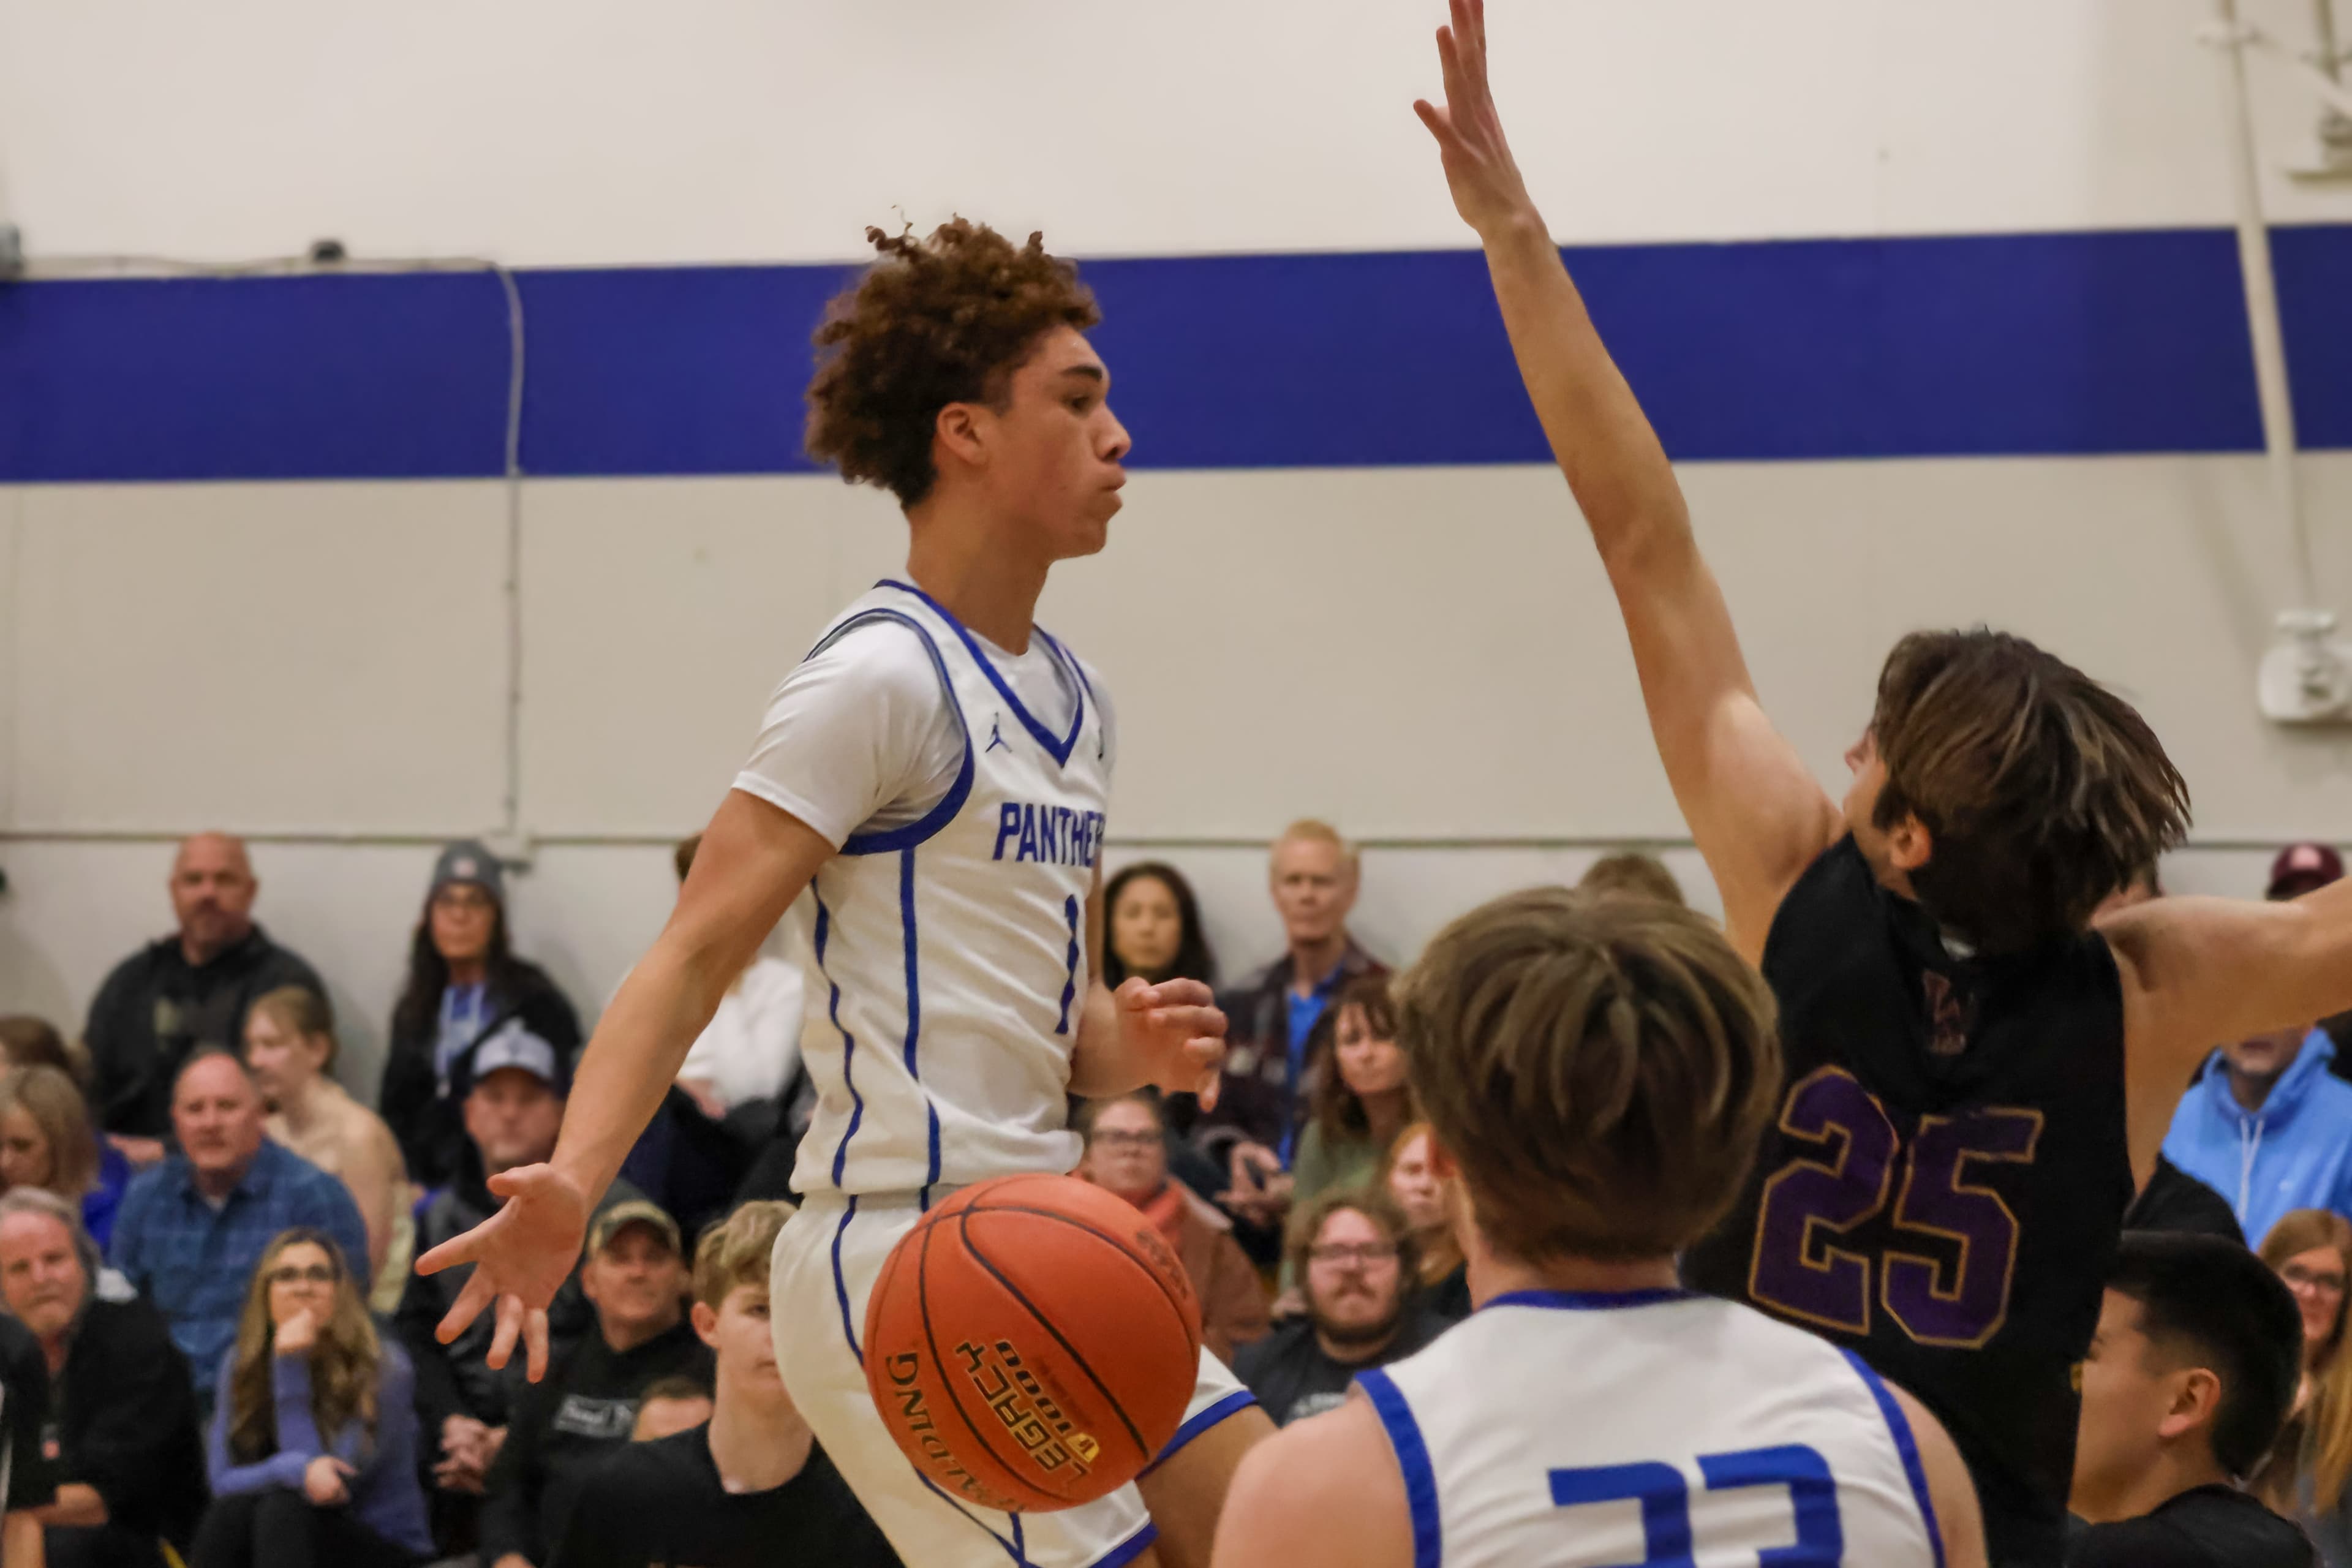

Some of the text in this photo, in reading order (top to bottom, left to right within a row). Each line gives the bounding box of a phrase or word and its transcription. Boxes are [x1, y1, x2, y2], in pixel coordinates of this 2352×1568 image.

[1054, 893, 1079, 1035] 1
[1748, 1065, 2044, 1350] 25
[886, 1352, 1024, 1512] ALDING
[955, 1341, 1090, 1485] LEGACY
[995, 1340, 1072, 1434] 1000
